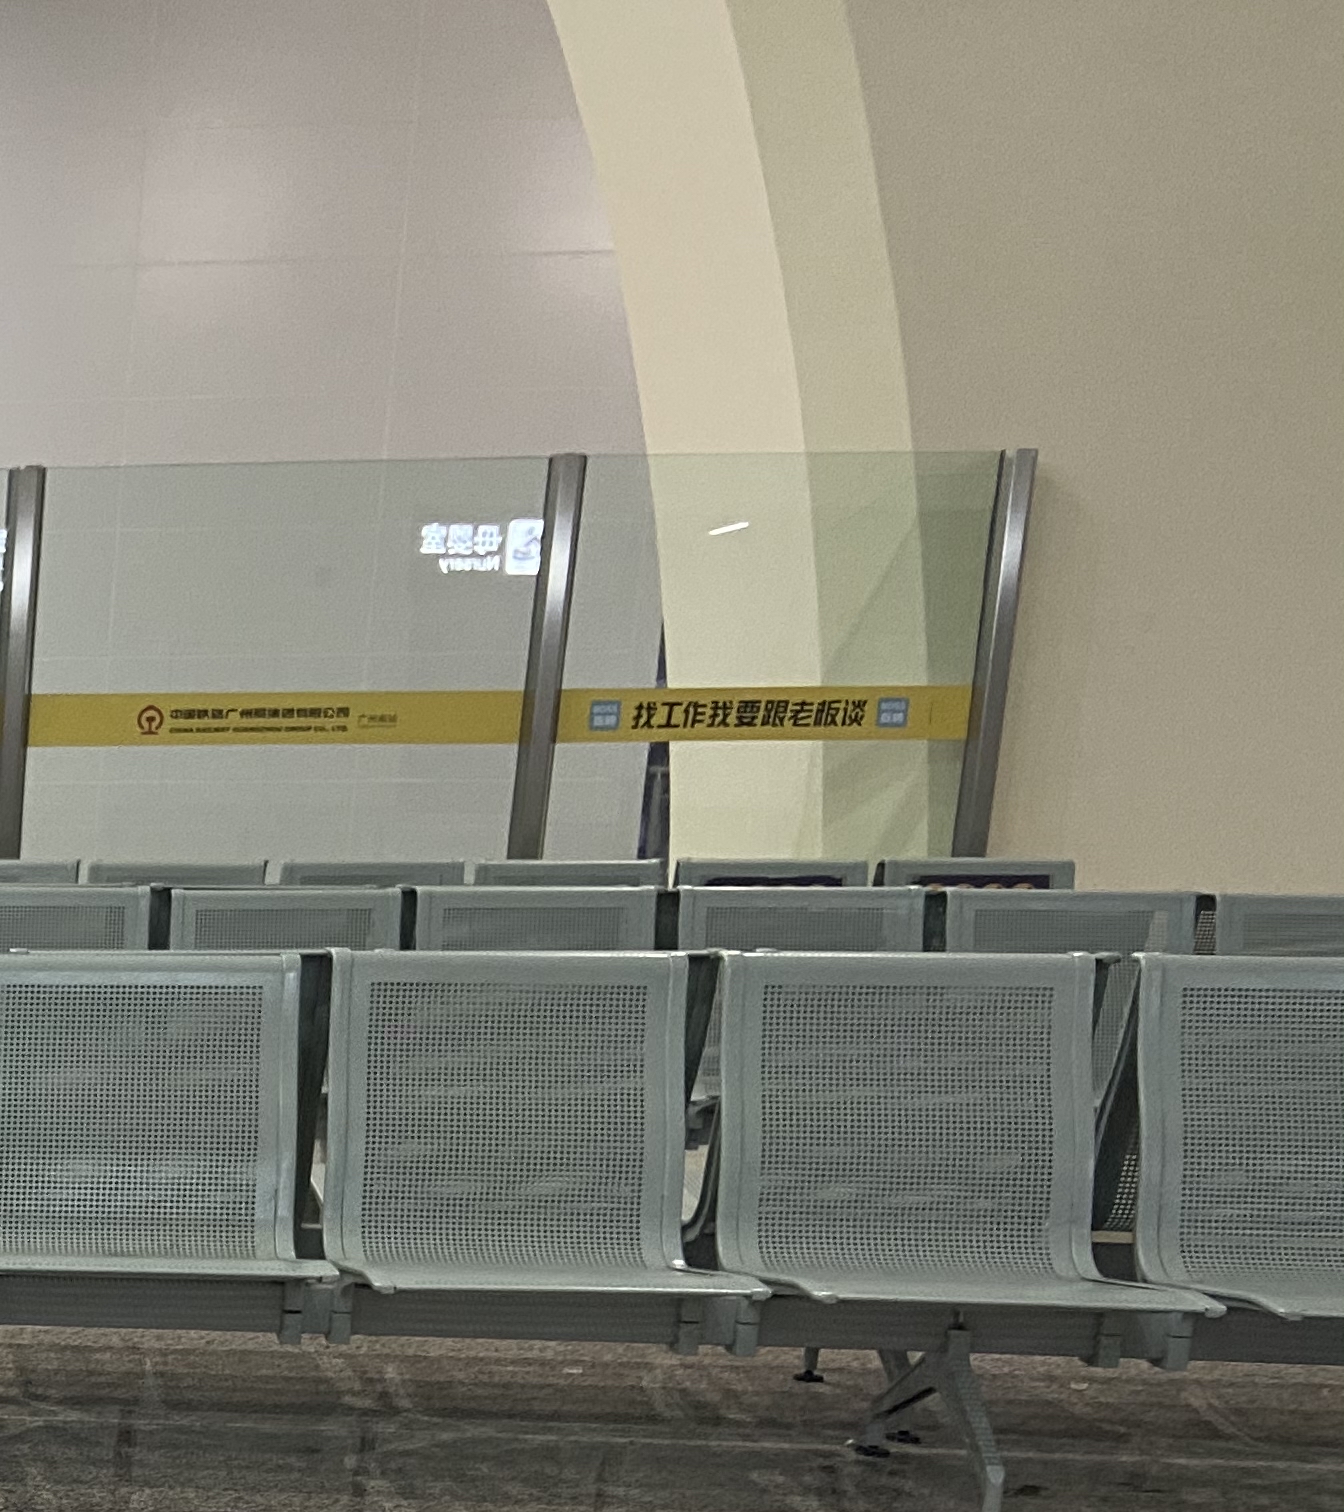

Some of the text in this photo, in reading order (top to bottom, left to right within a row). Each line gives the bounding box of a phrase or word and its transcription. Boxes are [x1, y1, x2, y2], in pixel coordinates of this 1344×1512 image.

[630, 699, 868, 730] 找工作我要跟老板谈
